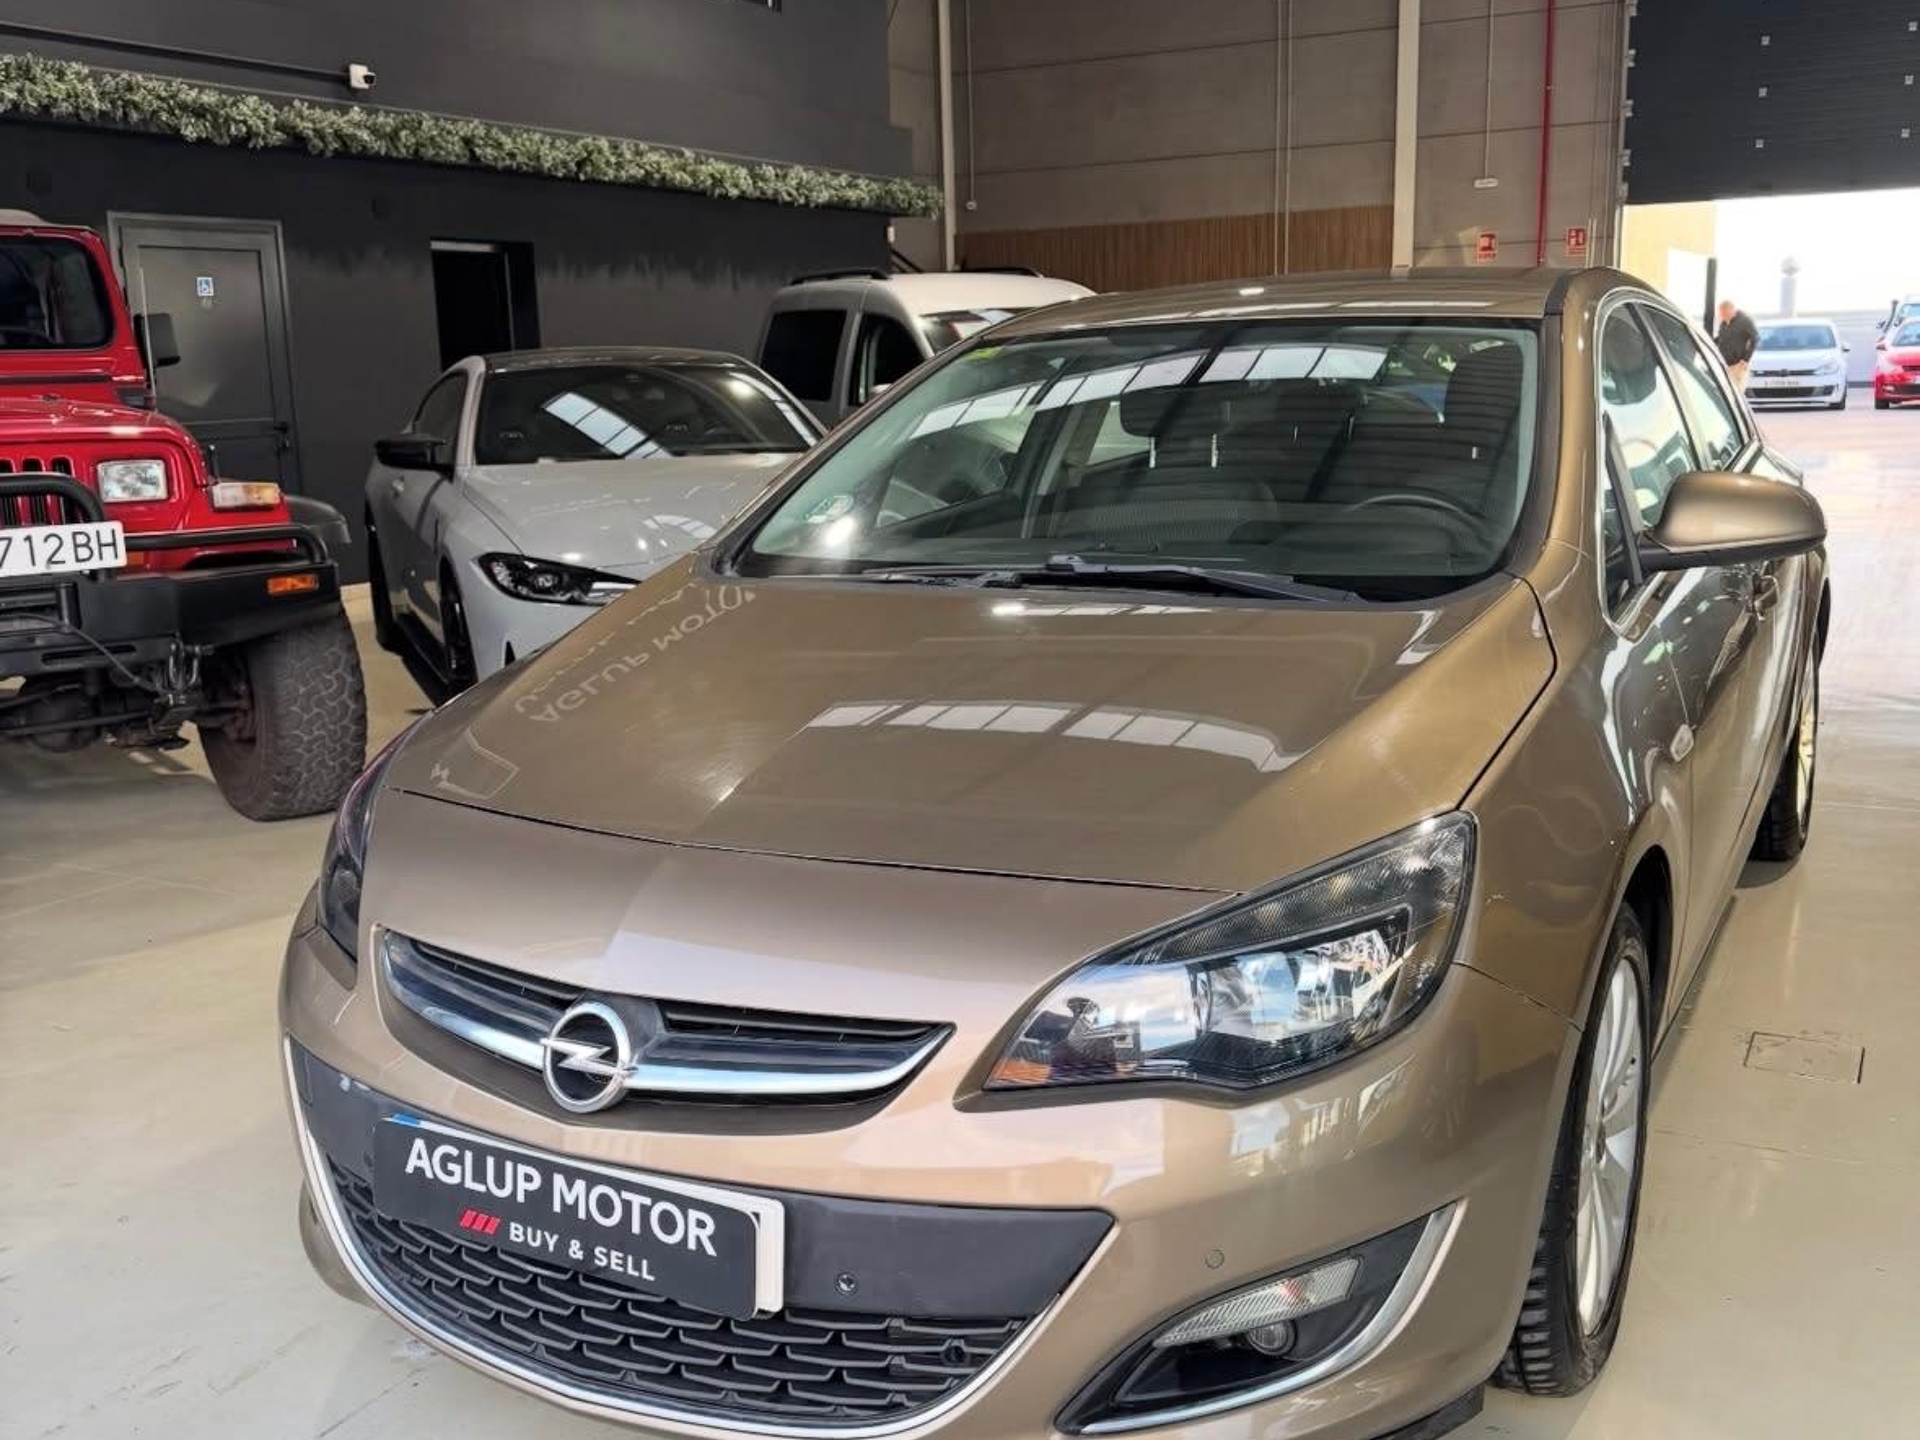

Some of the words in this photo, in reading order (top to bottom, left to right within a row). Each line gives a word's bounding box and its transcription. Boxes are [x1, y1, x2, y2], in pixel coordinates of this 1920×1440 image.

[405, 1137, 541, 1203] AGLUP
[553, 1173, 718, 1257] MOTOR
[509, 1221, 560, 1252] BUY
[568, 1239, 584, 1261] &
[593, 1246, 656, 1282] SELL
